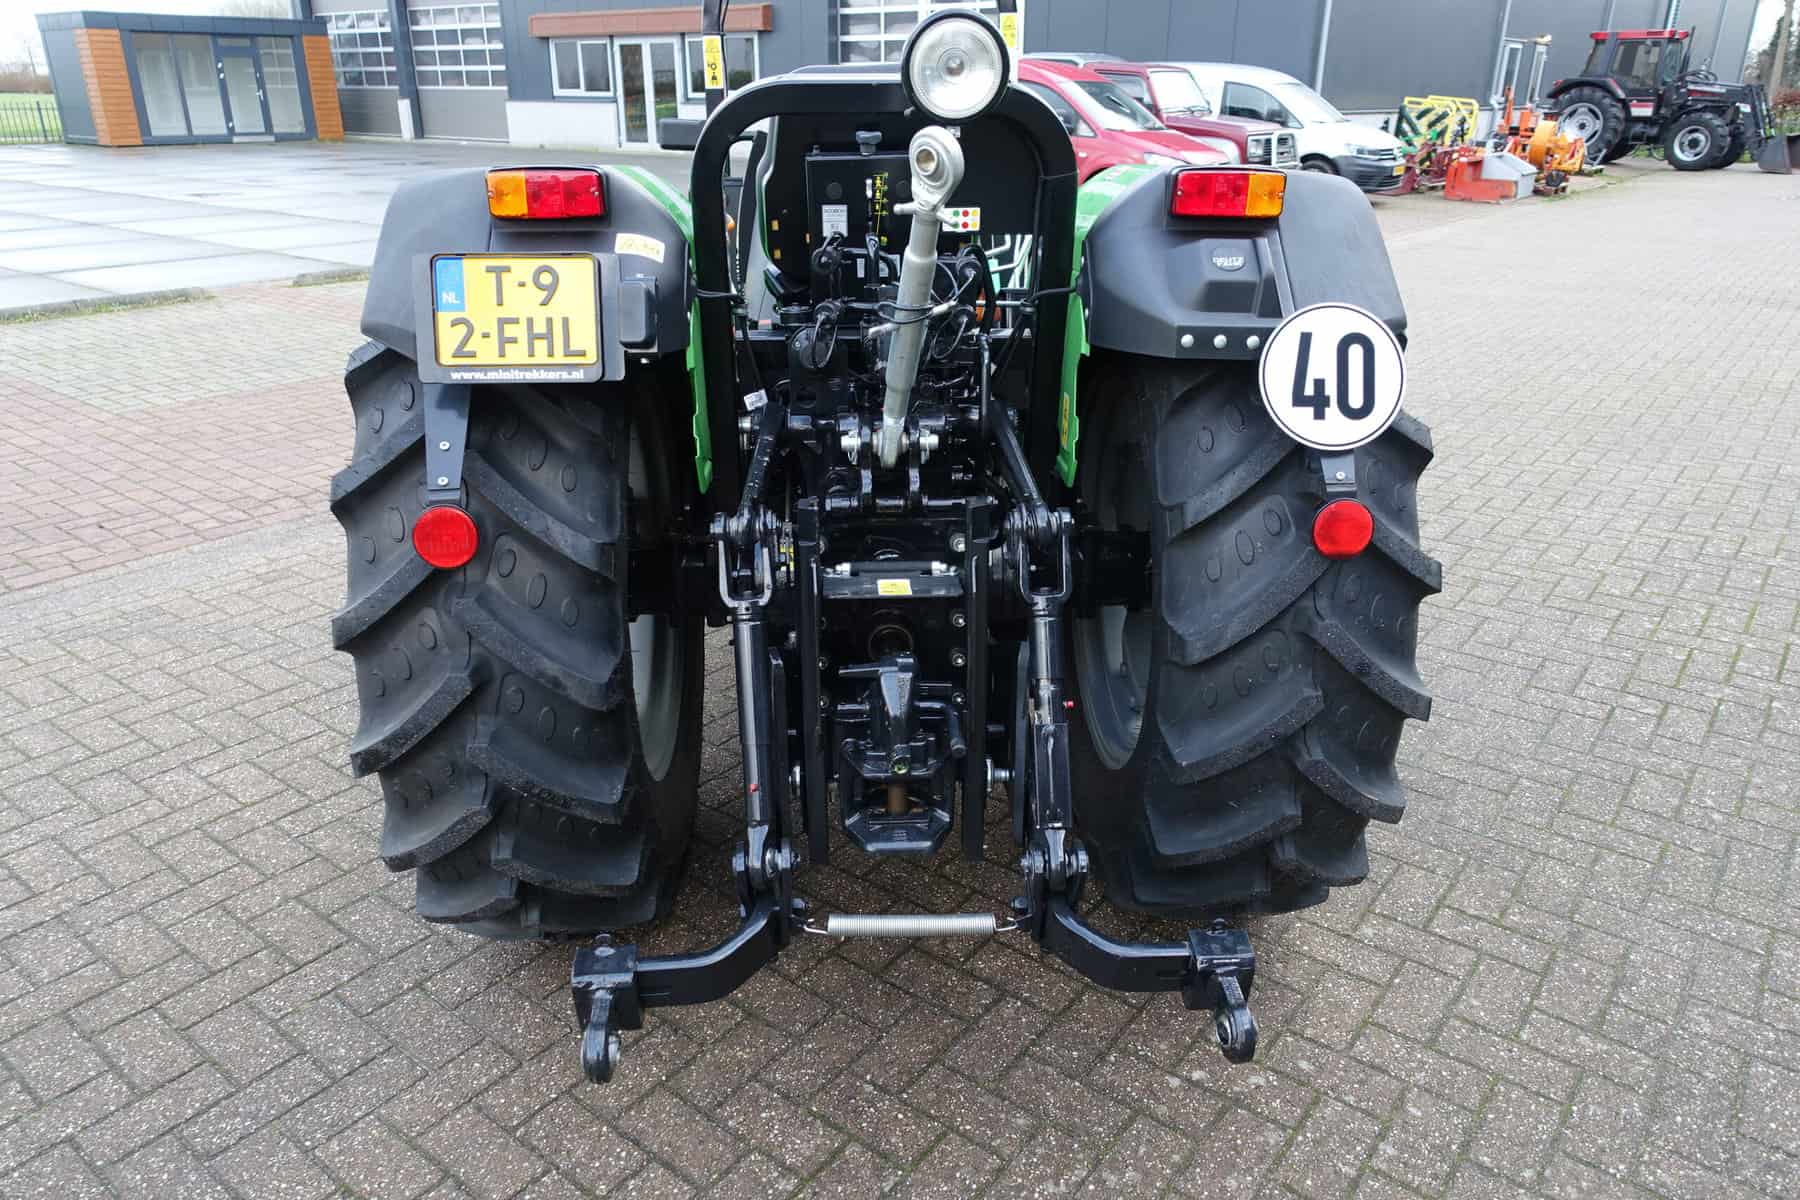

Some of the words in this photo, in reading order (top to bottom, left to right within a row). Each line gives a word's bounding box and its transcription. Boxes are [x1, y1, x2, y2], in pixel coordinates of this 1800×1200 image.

[441, 291, 461, 305] NL
[485, 264, 560, 307] T-9
[449, 316, 587, 359] 2-FHL
[450, 368, 585, 381] www.minitrekkers.nl
[1291, 331, 1376, 421] 40
